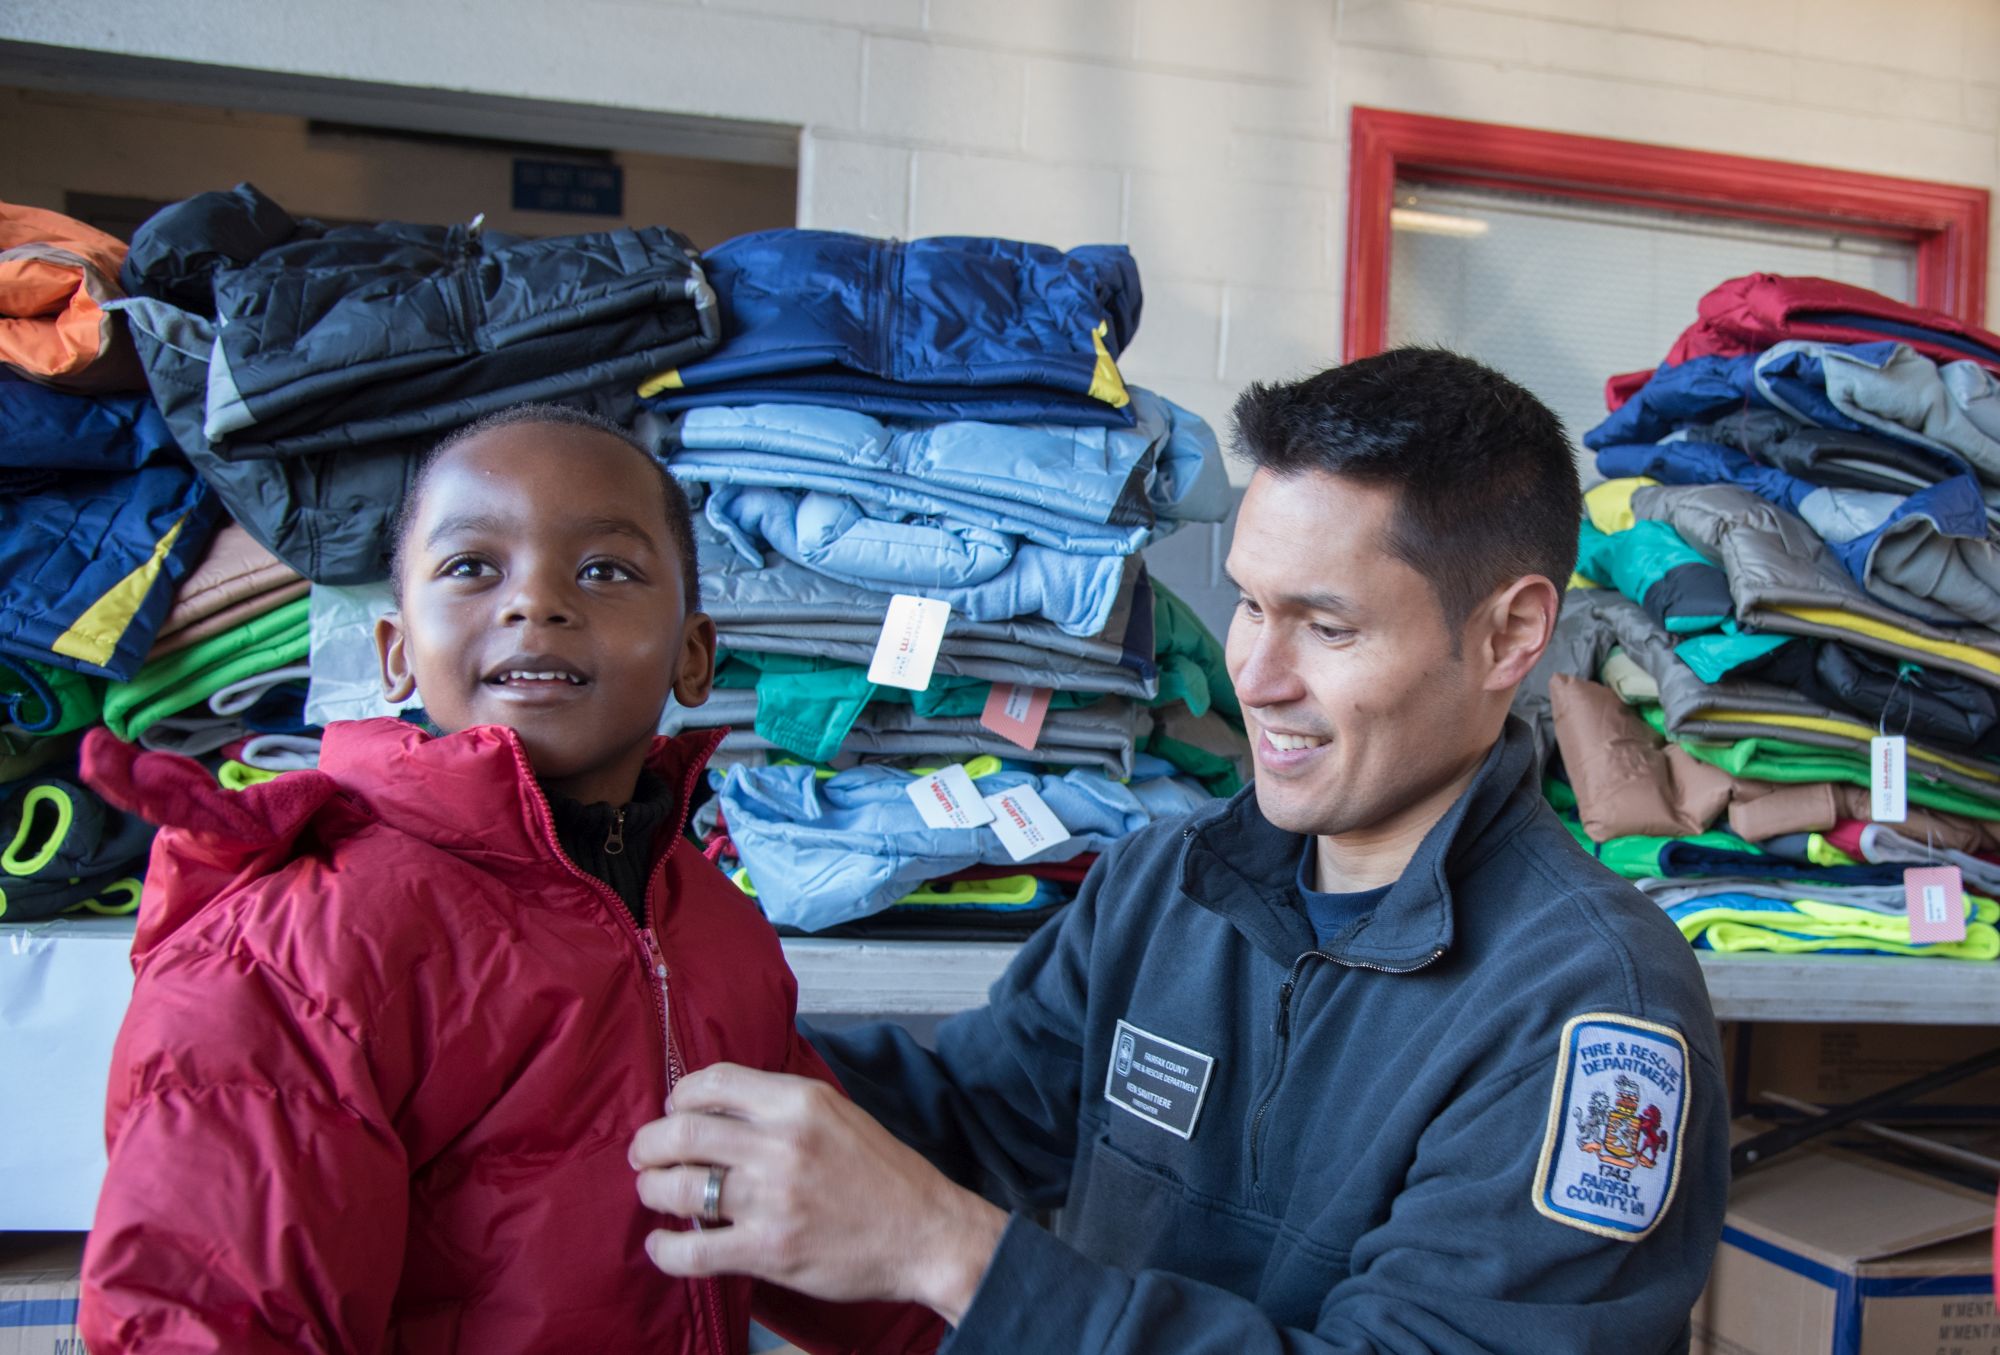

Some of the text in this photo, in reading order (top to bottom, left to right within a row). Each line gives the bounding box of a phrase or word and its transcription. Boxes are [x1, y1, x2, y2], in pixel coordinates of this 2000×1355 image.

[930, 782, 954, 812] warm
[1001, 799, 1027, 829] warm
[1165, 1060, 1189, 1076] COUNTY
[1580, 1042, 1680, 1084] FIRE & RESCUE
[1582, 1057, 1676, 1096] DEPARTMENT
[1163, 1073, 1199, 1094] DEPARTMENT
[1581, 1172, 1641, 1200] FAIRFAX
[1599, 1163, 1631, 1182] 1742
